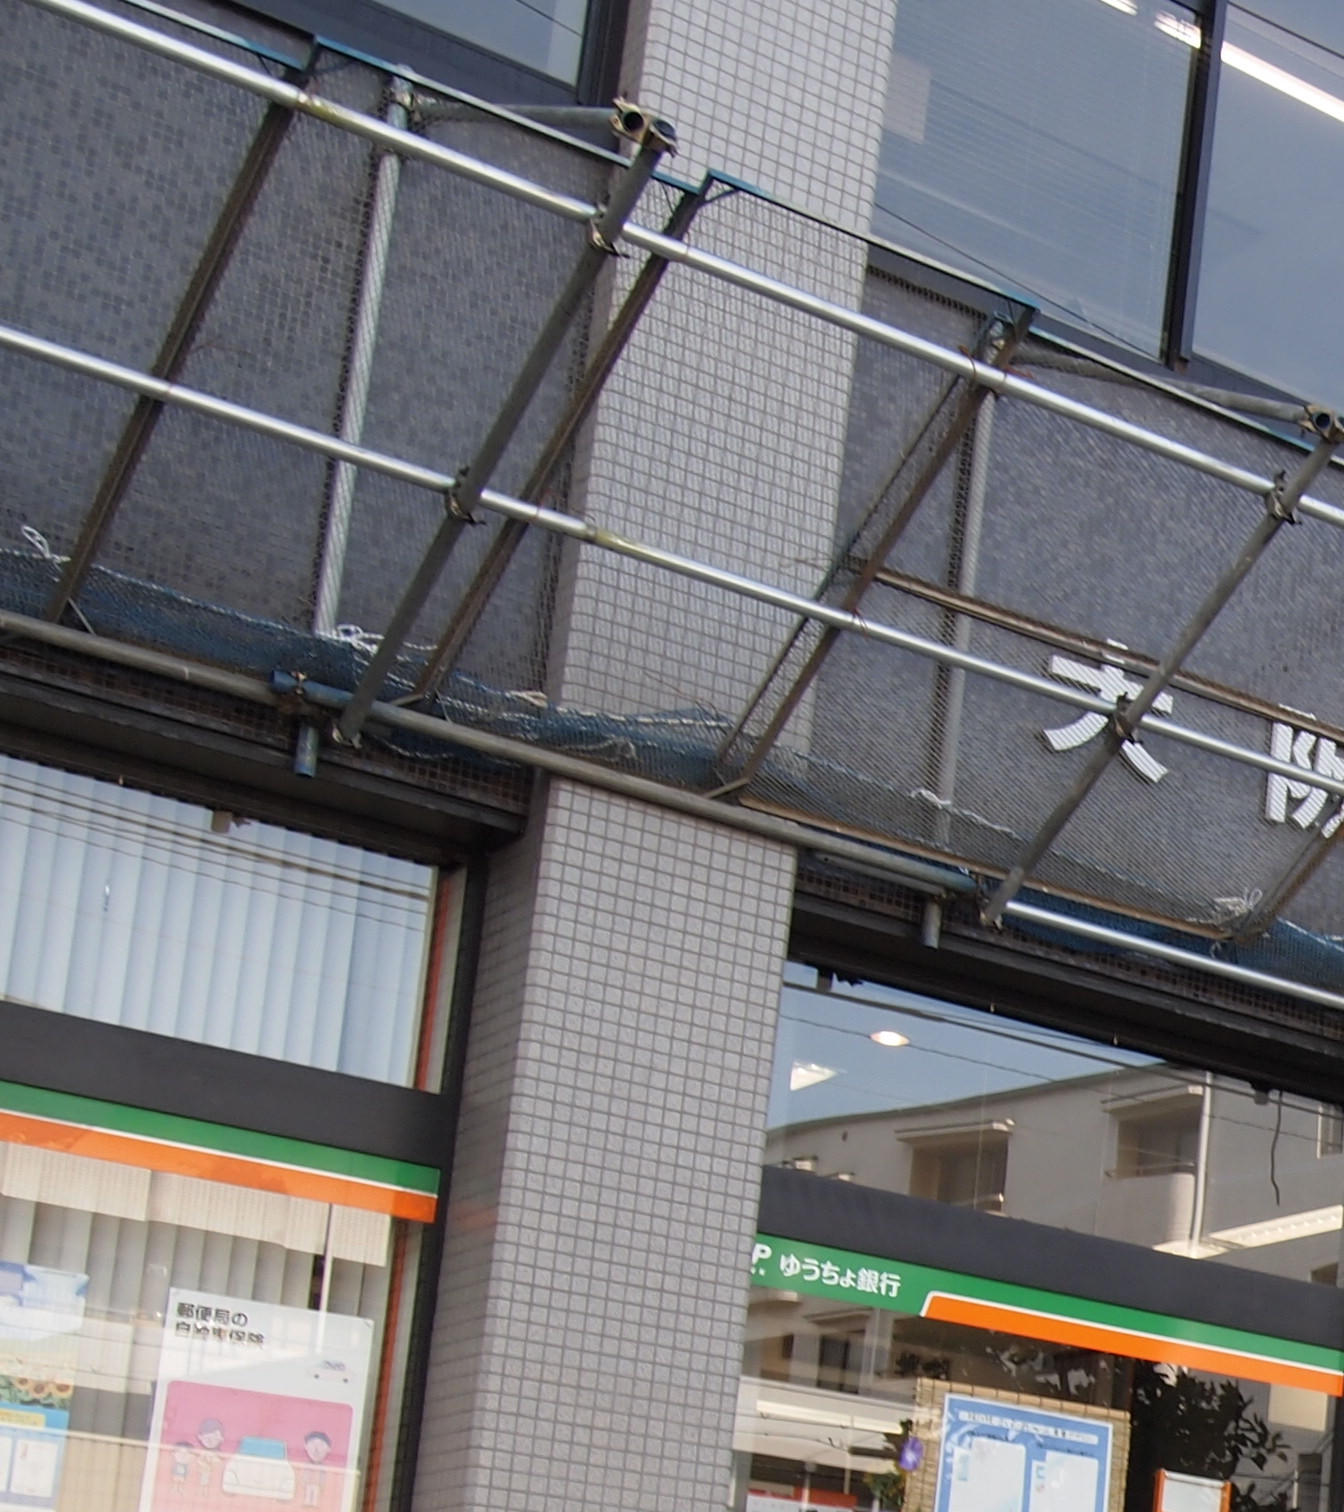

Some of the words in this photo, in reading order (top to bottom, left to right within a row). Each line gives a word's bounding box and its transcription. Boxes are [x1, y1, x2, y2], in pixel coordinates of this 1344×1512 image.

[779, 1252, 902, 1298] ゆうちょ銀行
[176, 1301, 249, 1328] 郵便局の
